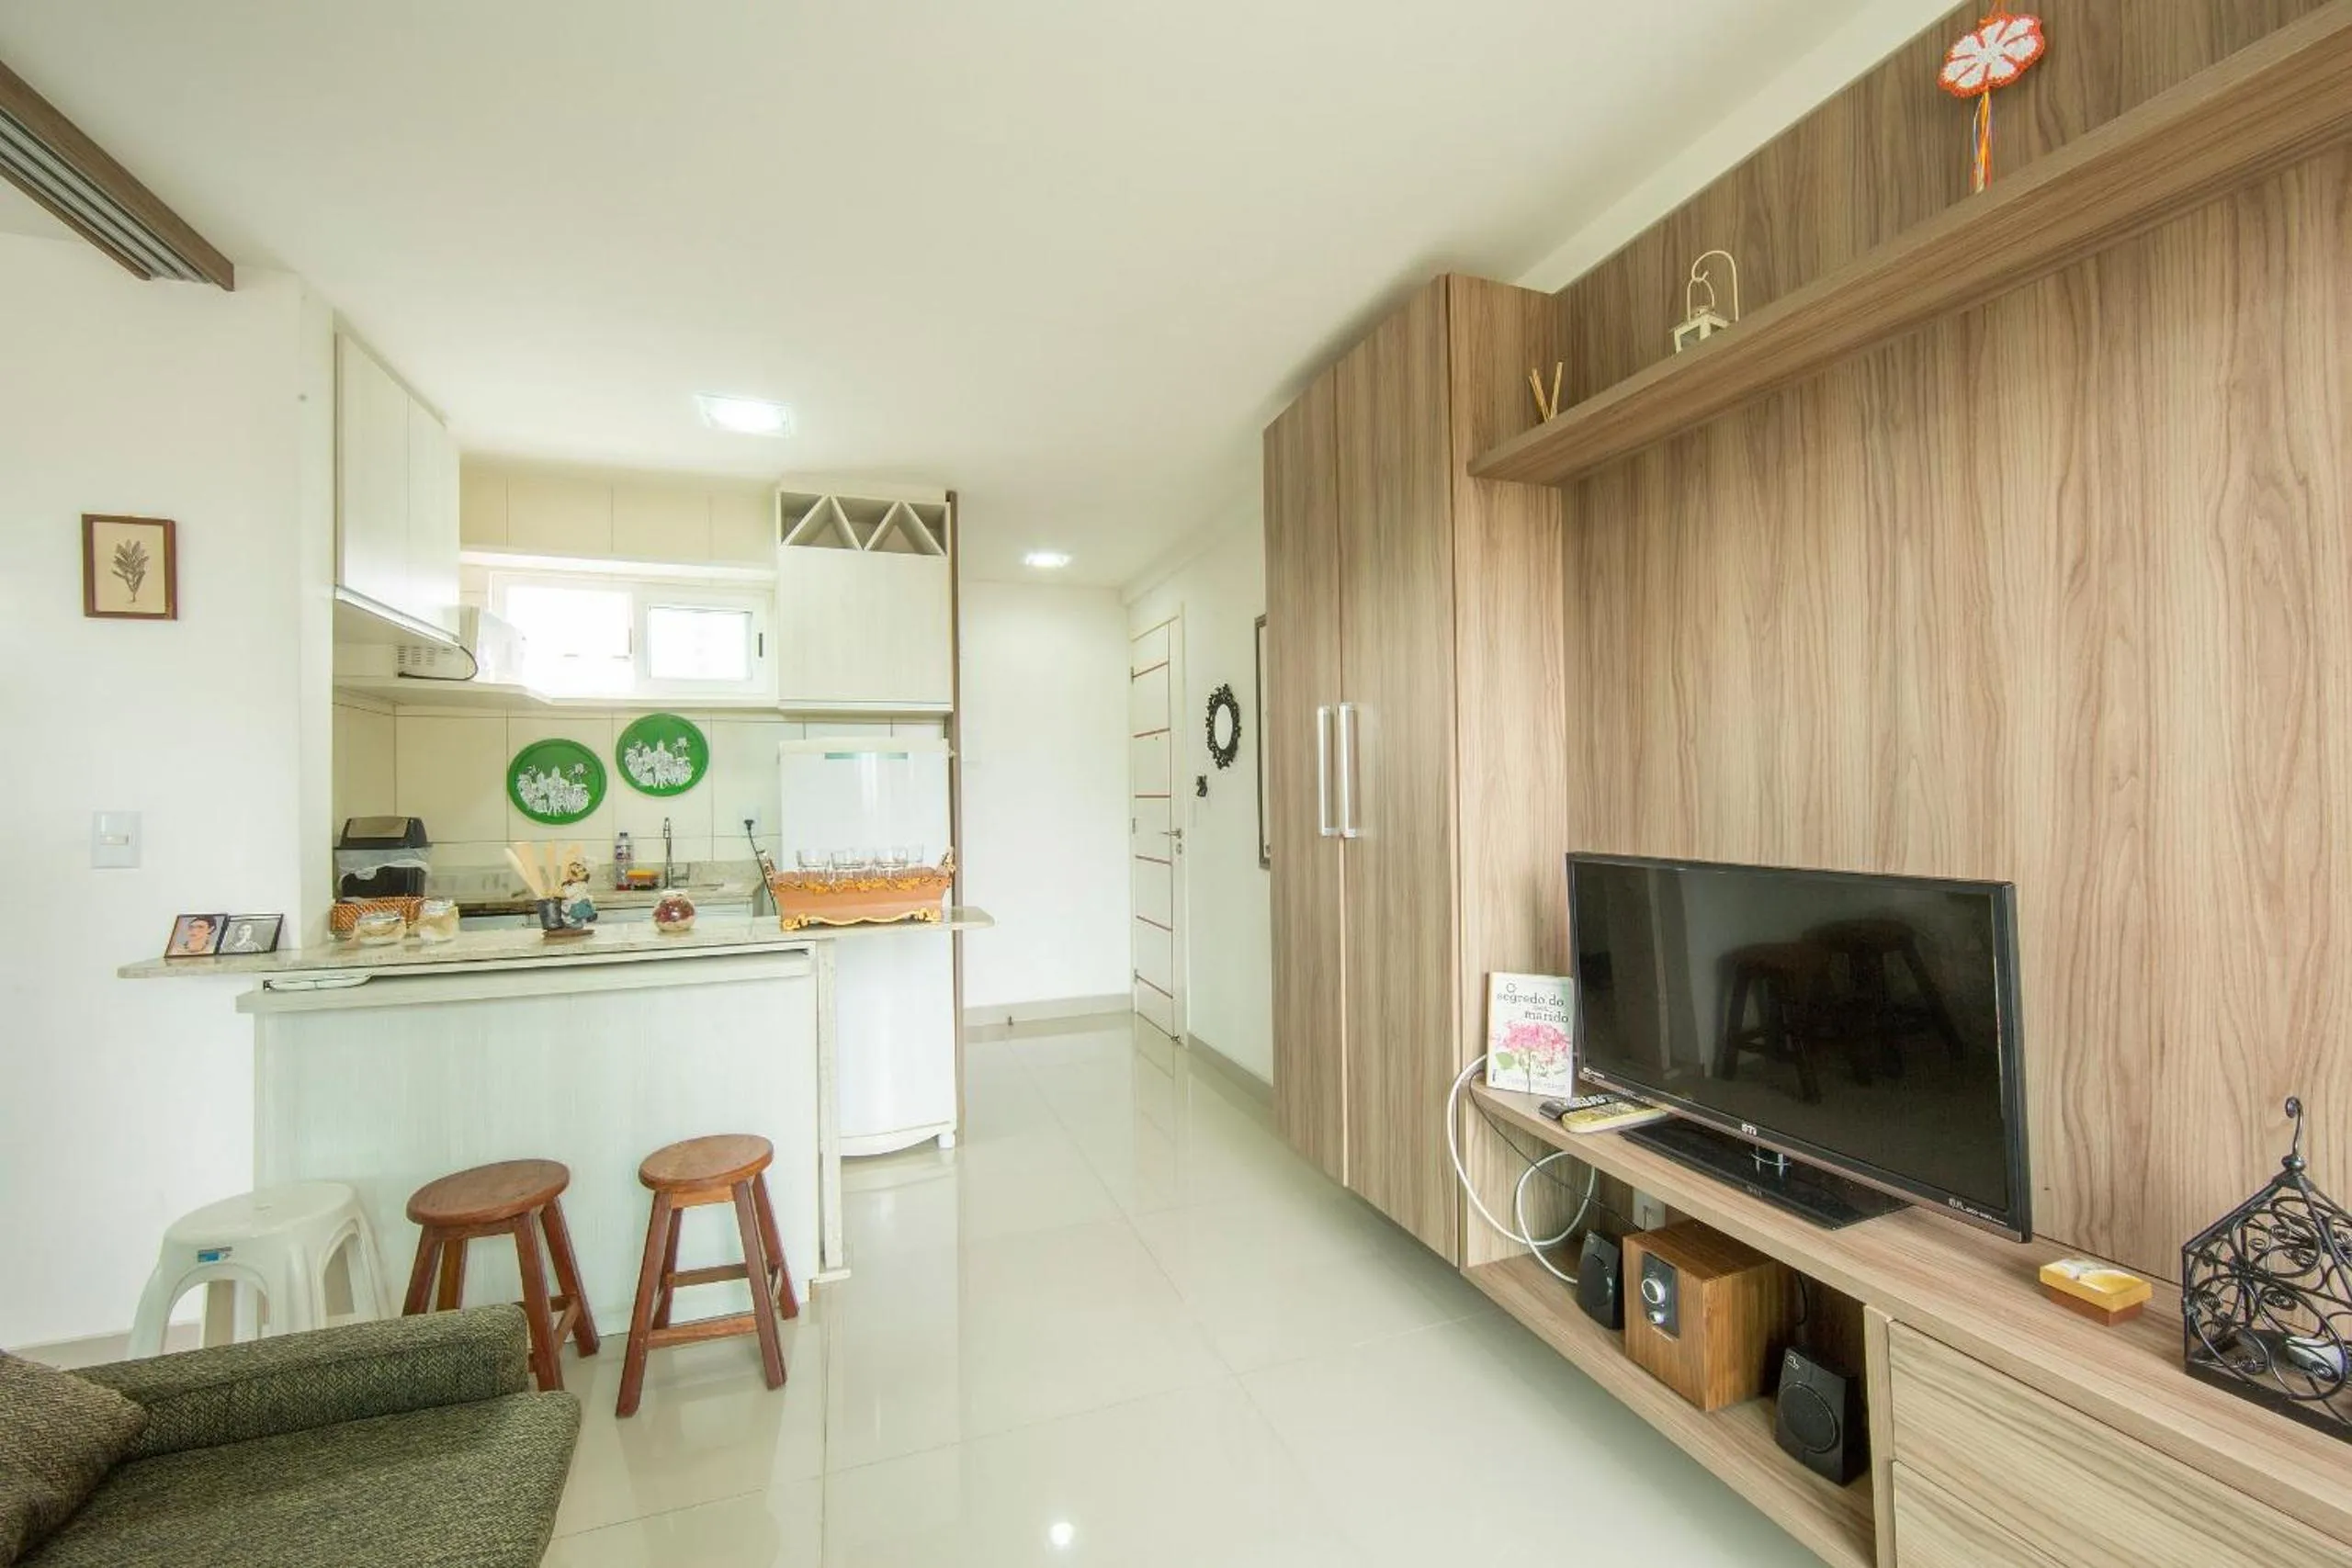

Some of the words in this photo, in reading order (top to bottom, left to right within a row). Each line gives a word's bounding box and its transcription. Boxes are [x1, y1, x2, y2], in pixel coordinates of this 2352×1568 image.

[1506, 983, 1517, 993] O
[1497, 993, 1544, 1003] segredo
[1549, 994, 1564, 1006] do
[1525, 1011, 1568, 1022] marido
